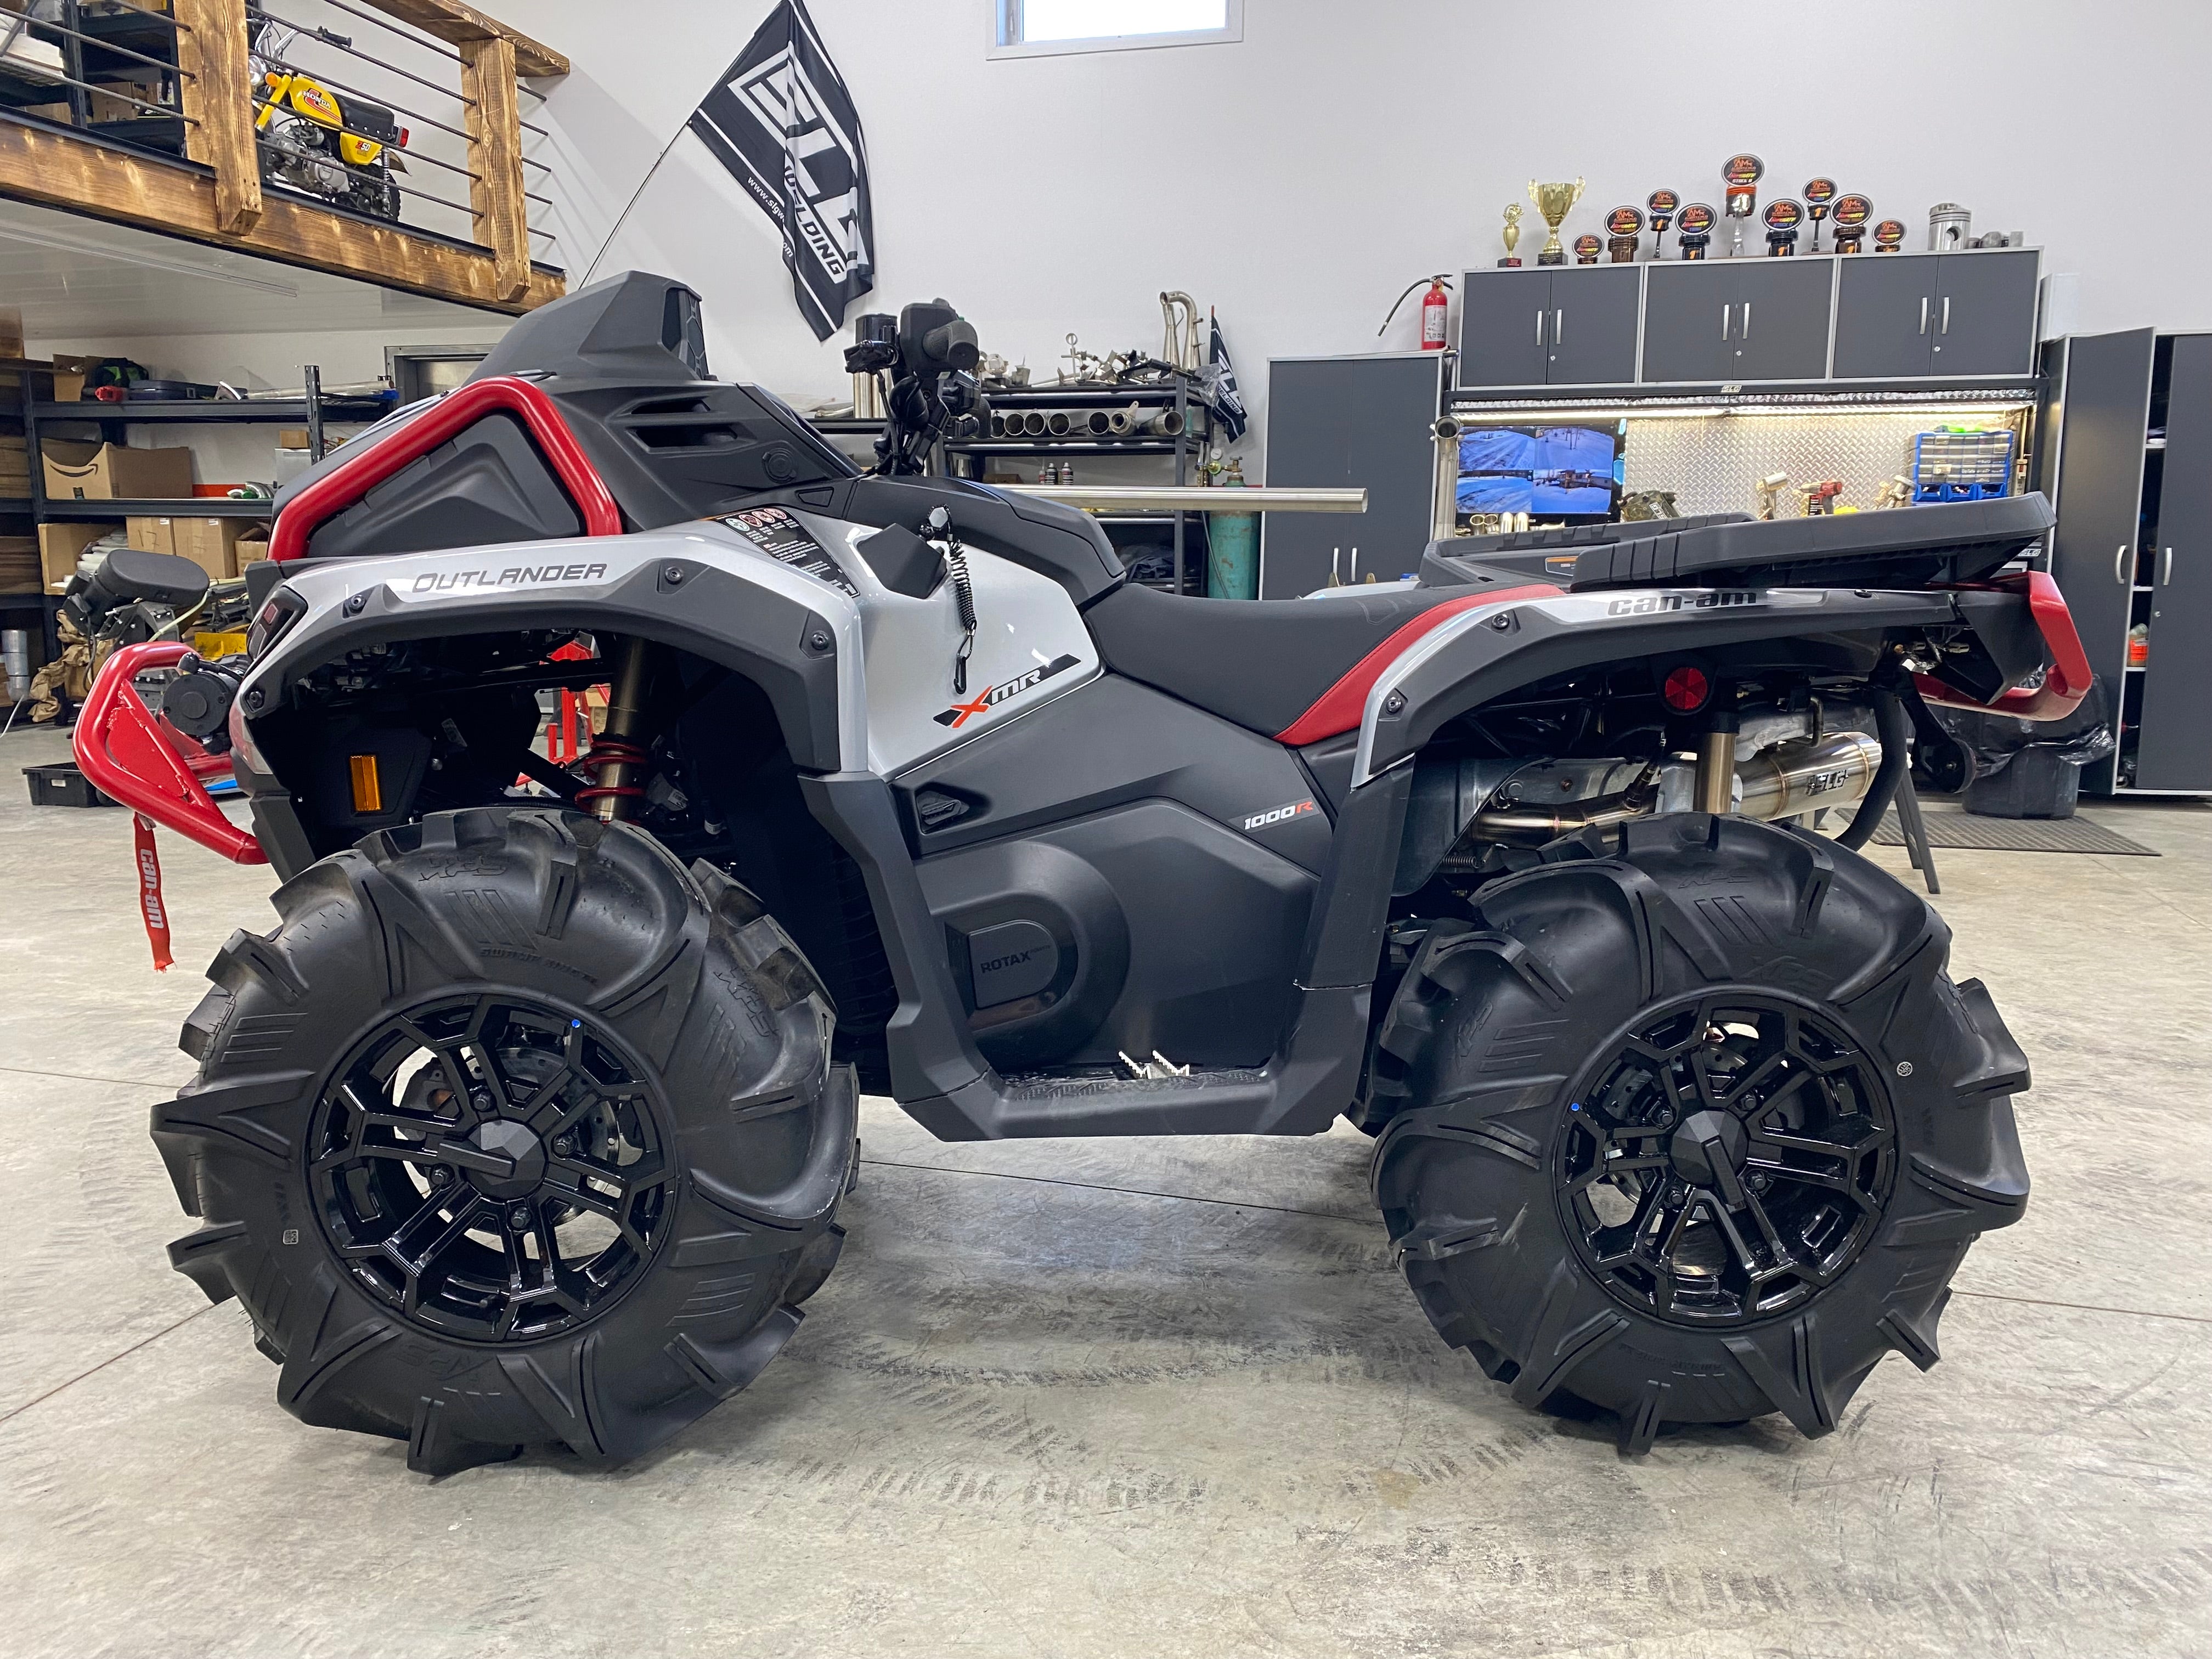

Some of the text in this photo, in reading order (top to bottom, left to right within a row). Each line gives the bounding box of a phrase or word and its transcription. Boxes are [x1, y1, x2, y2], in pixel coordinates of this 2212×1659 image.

[303, 90, 331, 109] HONDA
[356, 140, 372, 151] Z50
[411, 563, 607, 593] OUTLANDER
[1607, 591, 1756, 616] can-am
[1814, 769, 1848, 791] SLG
[1244, 801, 1314, 830] 1000R
[140, 848, 164, 929] can-am
[980, 950, 1031, 973] ROTAX
